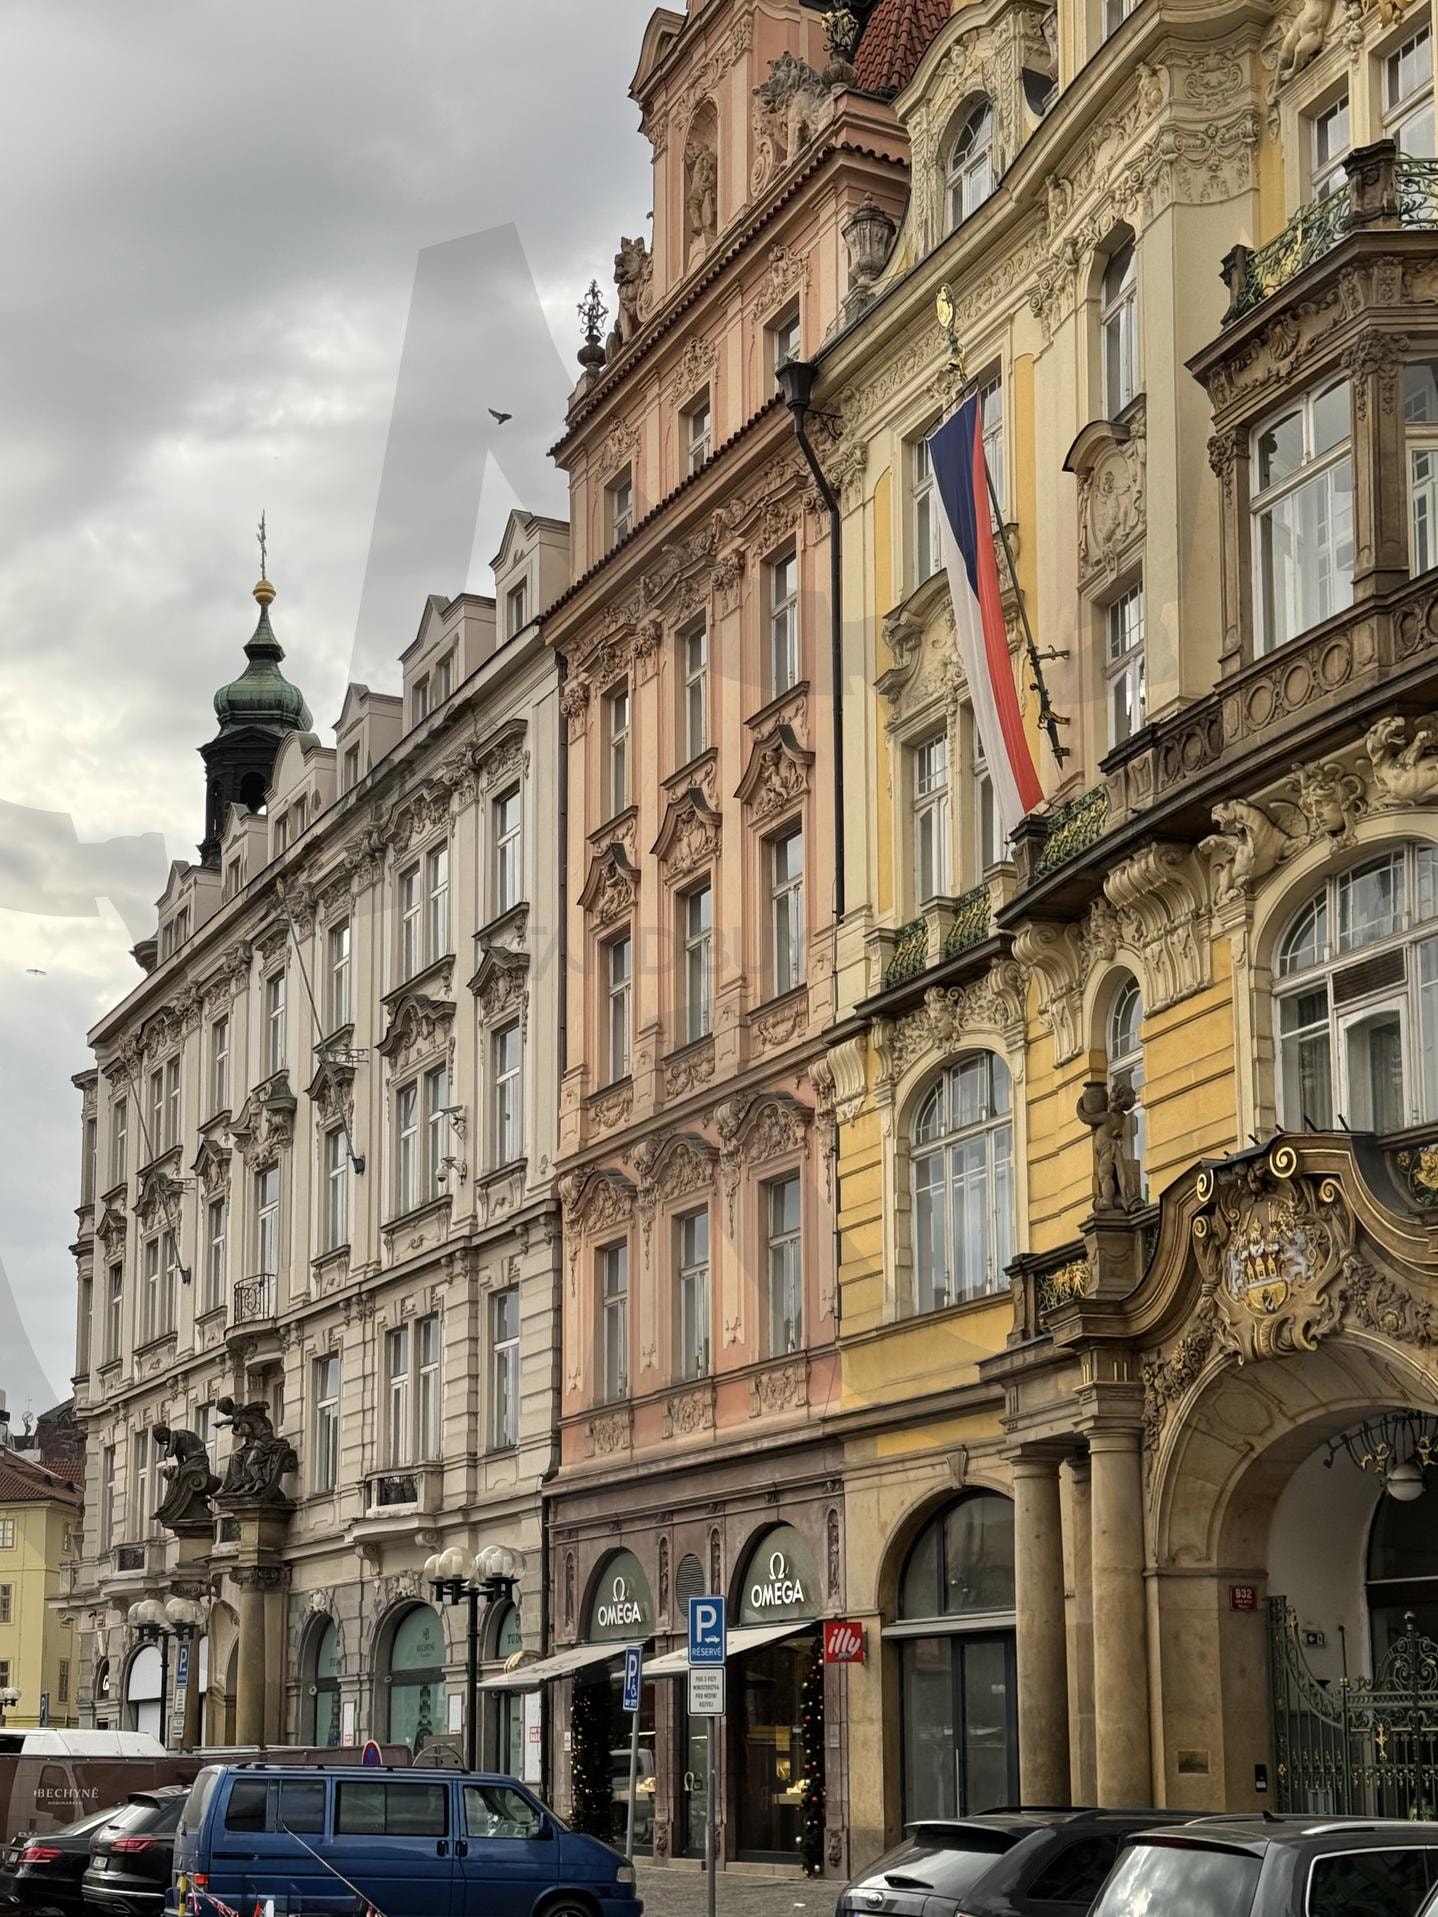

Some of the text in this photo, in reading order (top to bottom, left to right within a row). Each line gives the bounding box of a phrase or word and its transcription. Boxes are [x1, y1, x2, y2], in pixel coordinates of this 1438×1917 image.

[751, 1578, 804, 1609] OMEGA
[598, 1601, 641, 1628] OMEGA
[696, 1604, 717, 1643] P
[692, 1646, 722, 1657] RÉSERVÉ
[828, 1628, 862, 1656] illy
[627, 1654, 638, 1691] P
